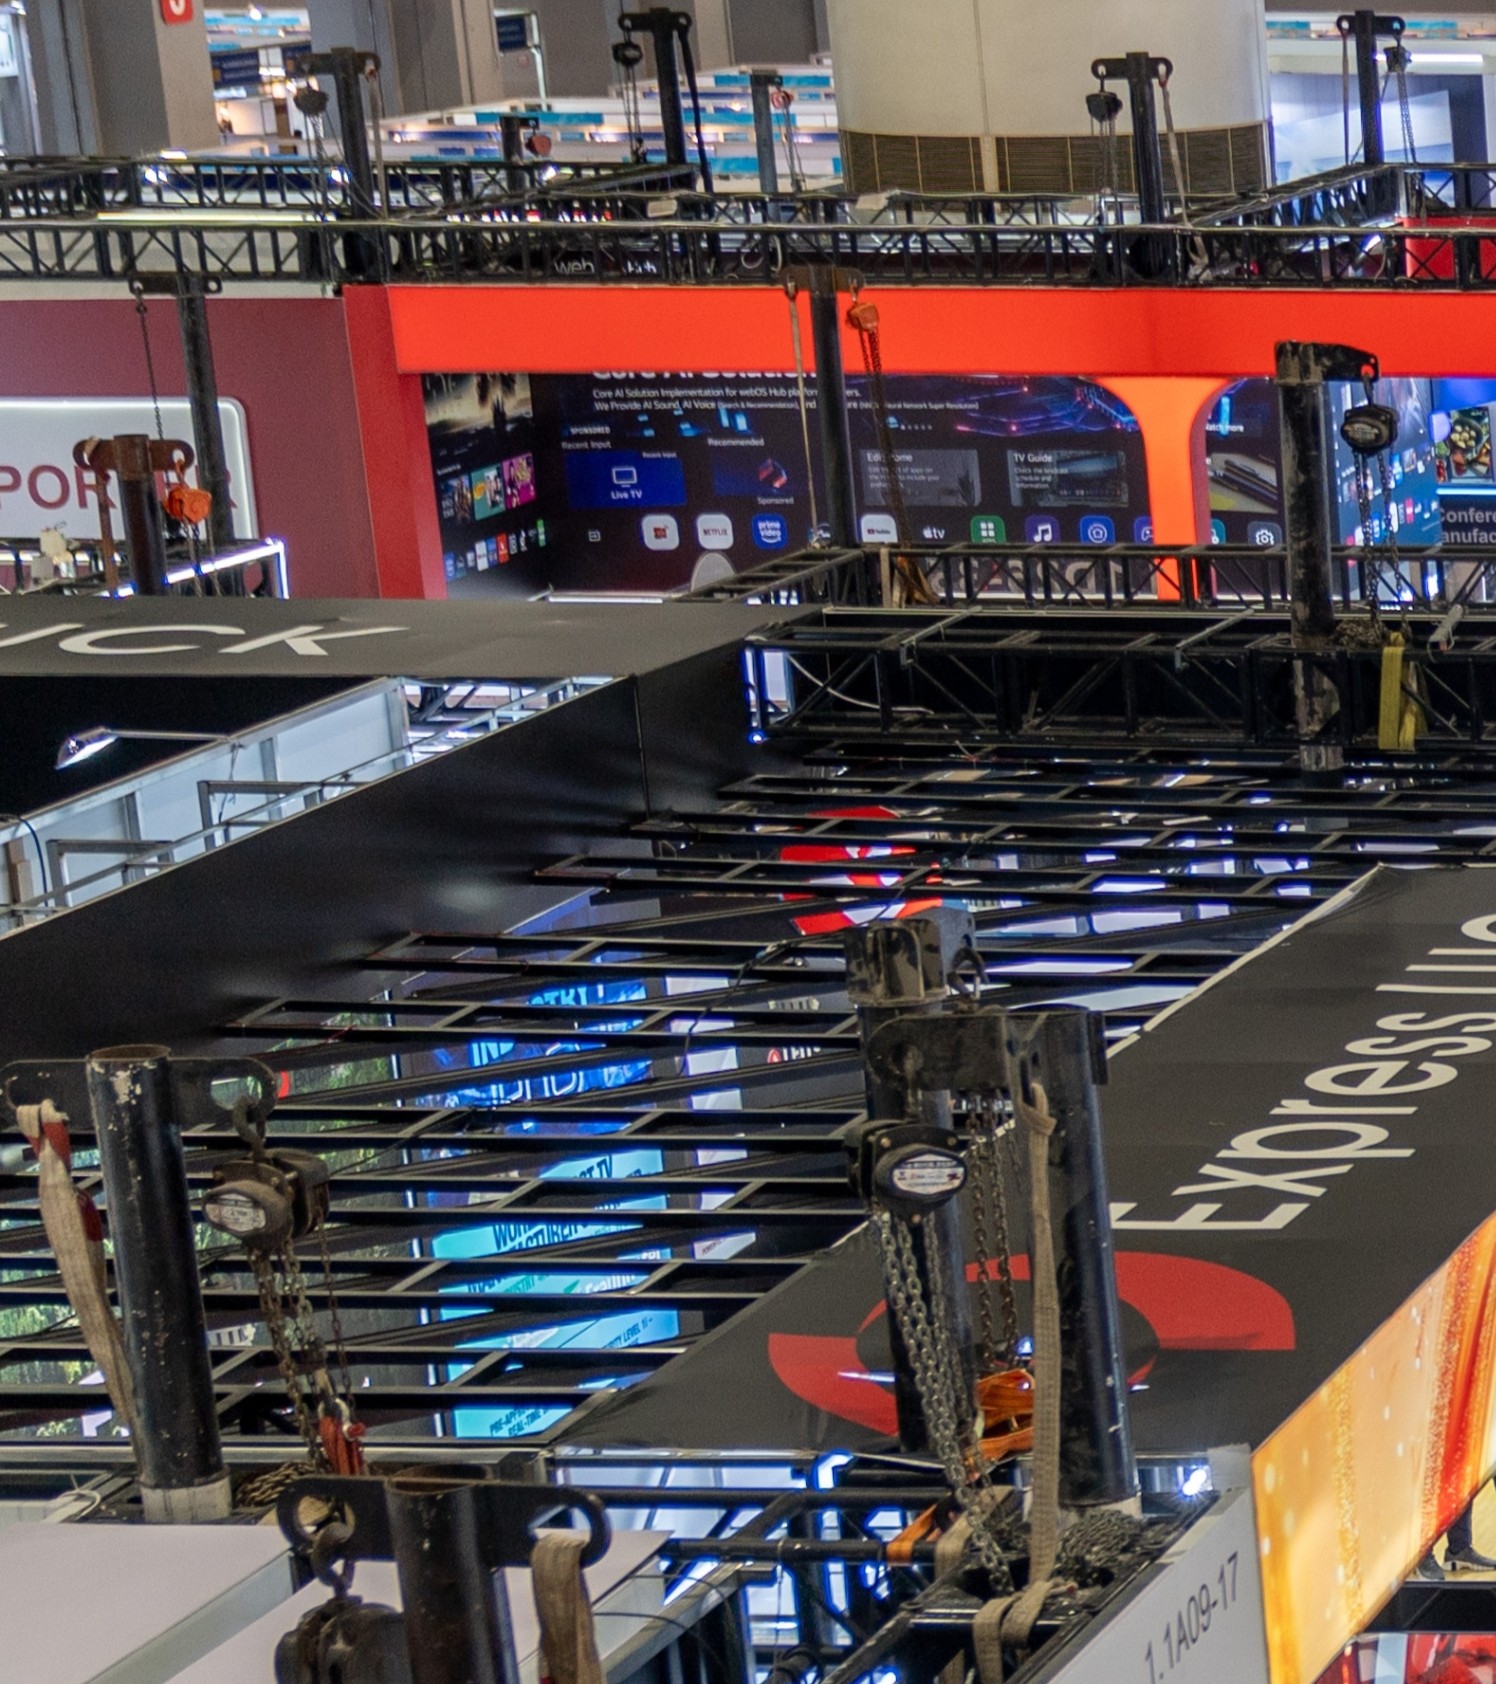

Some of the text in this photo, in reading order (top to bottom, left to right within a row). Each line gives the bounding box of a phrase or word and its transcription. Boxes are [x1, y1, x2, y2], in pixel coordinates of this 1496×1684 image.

[626, 387, 659, 399] Solution
[660, 387, 724, 401] Implementation
[611, 401, 642, 412] Provide
[626, 490, 643, 499] TV
